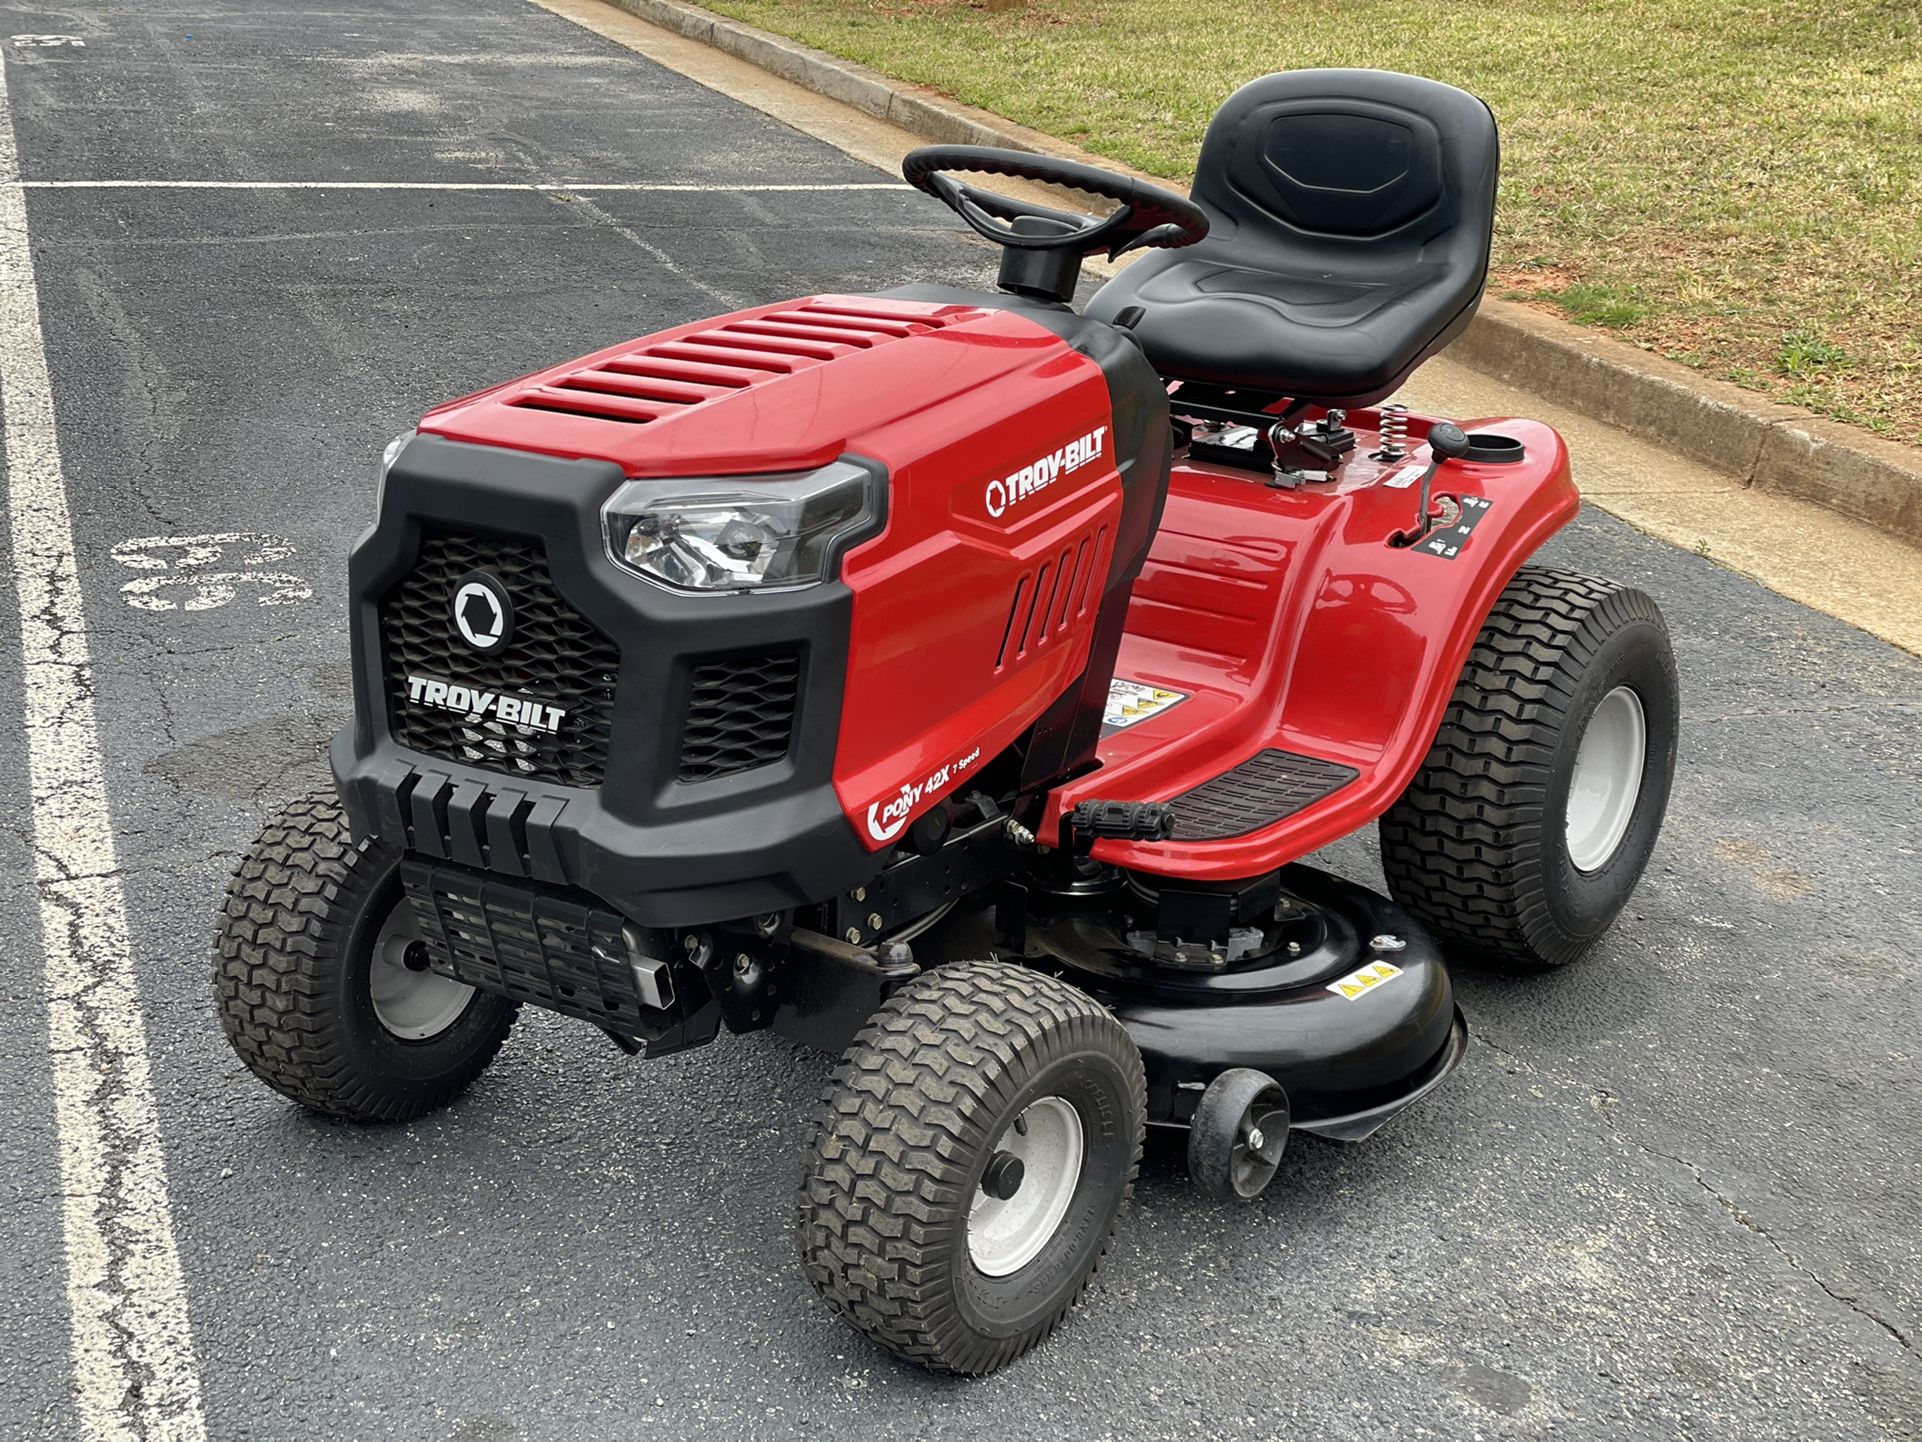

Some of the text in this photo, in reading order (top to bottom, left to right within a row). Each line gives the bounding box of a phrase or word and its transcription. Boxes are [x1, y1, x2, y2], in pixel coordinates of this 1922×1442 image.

[1005, 425, 1105, 505] TROY-BILT
[1444, 546, 1458, 556] F
[1458, 525, 1470, 535] N
[111, 532, 314, 611] 66
[408, 676, 566, 734] TROY-BILT
[882, 746, 980, 824] PONY 42X 7 Speed
